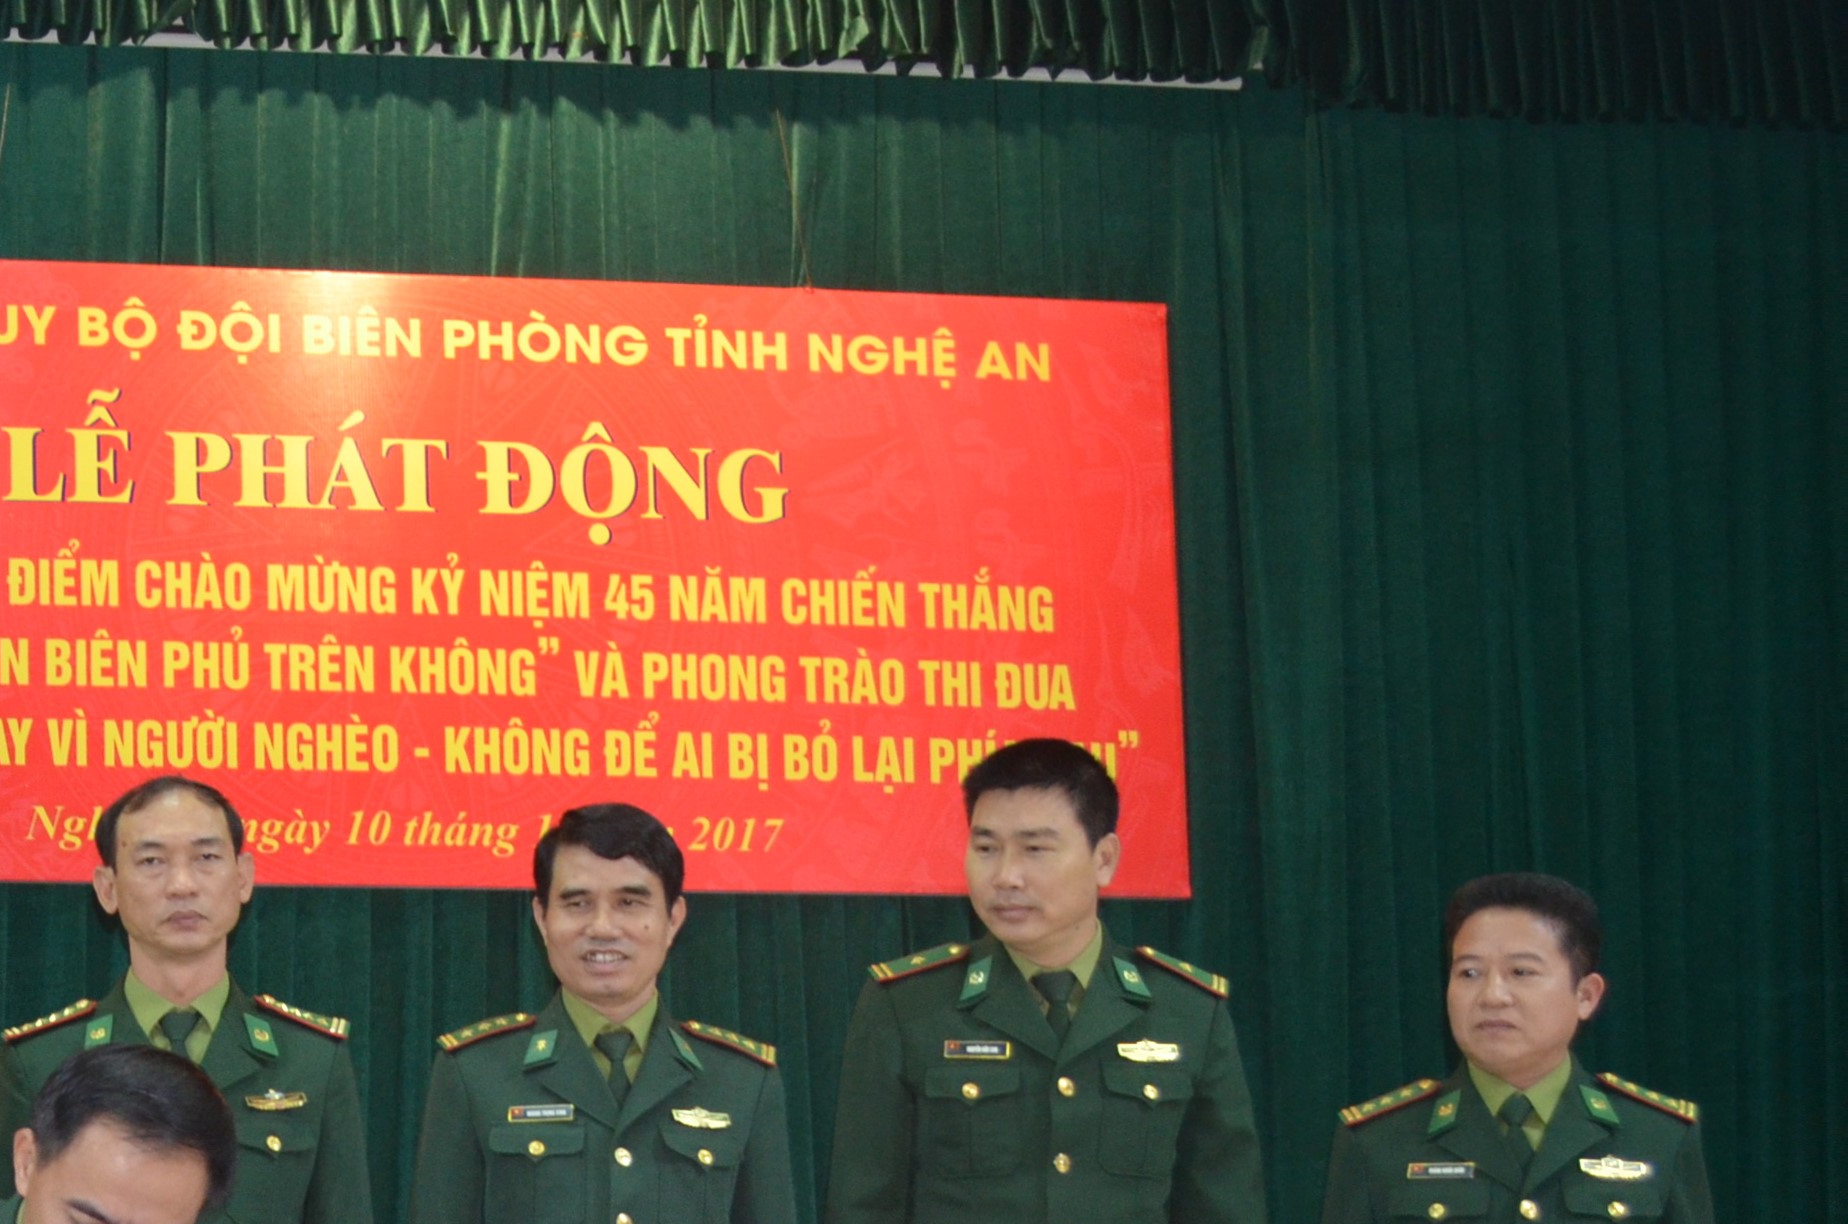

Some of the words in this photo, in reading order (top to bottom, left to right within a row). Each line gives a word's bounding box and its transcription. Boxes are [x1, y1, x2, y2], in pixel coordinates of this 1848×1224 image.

[77, 296, 158, 361] BỘ
[176, 300, 280, 365] ĐỘI
[304, 304, 422, 358] BIÊN
[443, 309, 649, 367] PHÒNG
[664, 313, 788, 372] TỈNH
[807, 326, 957, 390] NGHỆ
[975, 340, 1051, 382] AN
[1, 387, 133, 504] LỄ
[164, 409, 447, 513] PHÁT
[475, 420, 789, 546] ĐỘNG
[6, 538, 120, 608] ĐIỂM
[134, 554, 252, 611] CHÀO
[266, 554, 397, 614] MỪNG
[411, 551, 466, 616] KỶ
[479, 560, 591, 628] NIỆM
[603, 573, 656, 621] 45
[668, 565, 767, 624] NĂM
[781, 564, 906, 628] CHIẾN
[917, 566, 1055, 633] THẮNG
[45, 629, 148, 688] BIÊN
[162, 625, 250, 690] PHỦ
[263, 635, 375, 693] TRÊN
[573, 640, 630, 699] VÀ
[642, 652, 787, 703] PHONG
[798, 648, 906, 706] TRÀO
[917, 660, 982, 708] THI
[994, 662, 1077, 711] ĐUA
[46, 708, 88, 768] VÌ
[103, 709, 239, 770] NGƯỜI
[253, 714, 400, 773] NGHÈO
[413, 746, 431, 758] -
[444, 717, 591, 777] KHÔNG
[603, 711, 659, 778] ĐỂ
[671, 731, 714, 779] AI
[727, 732, 769, 792] BỊ
[783, 718, 839, 783] BỎ
[852, 735, 916, 794] LẠI
[346, 810, 392, 846] 10
[403, 811, 520, 858] tháng
[687, 816, 785, 852] 2017
